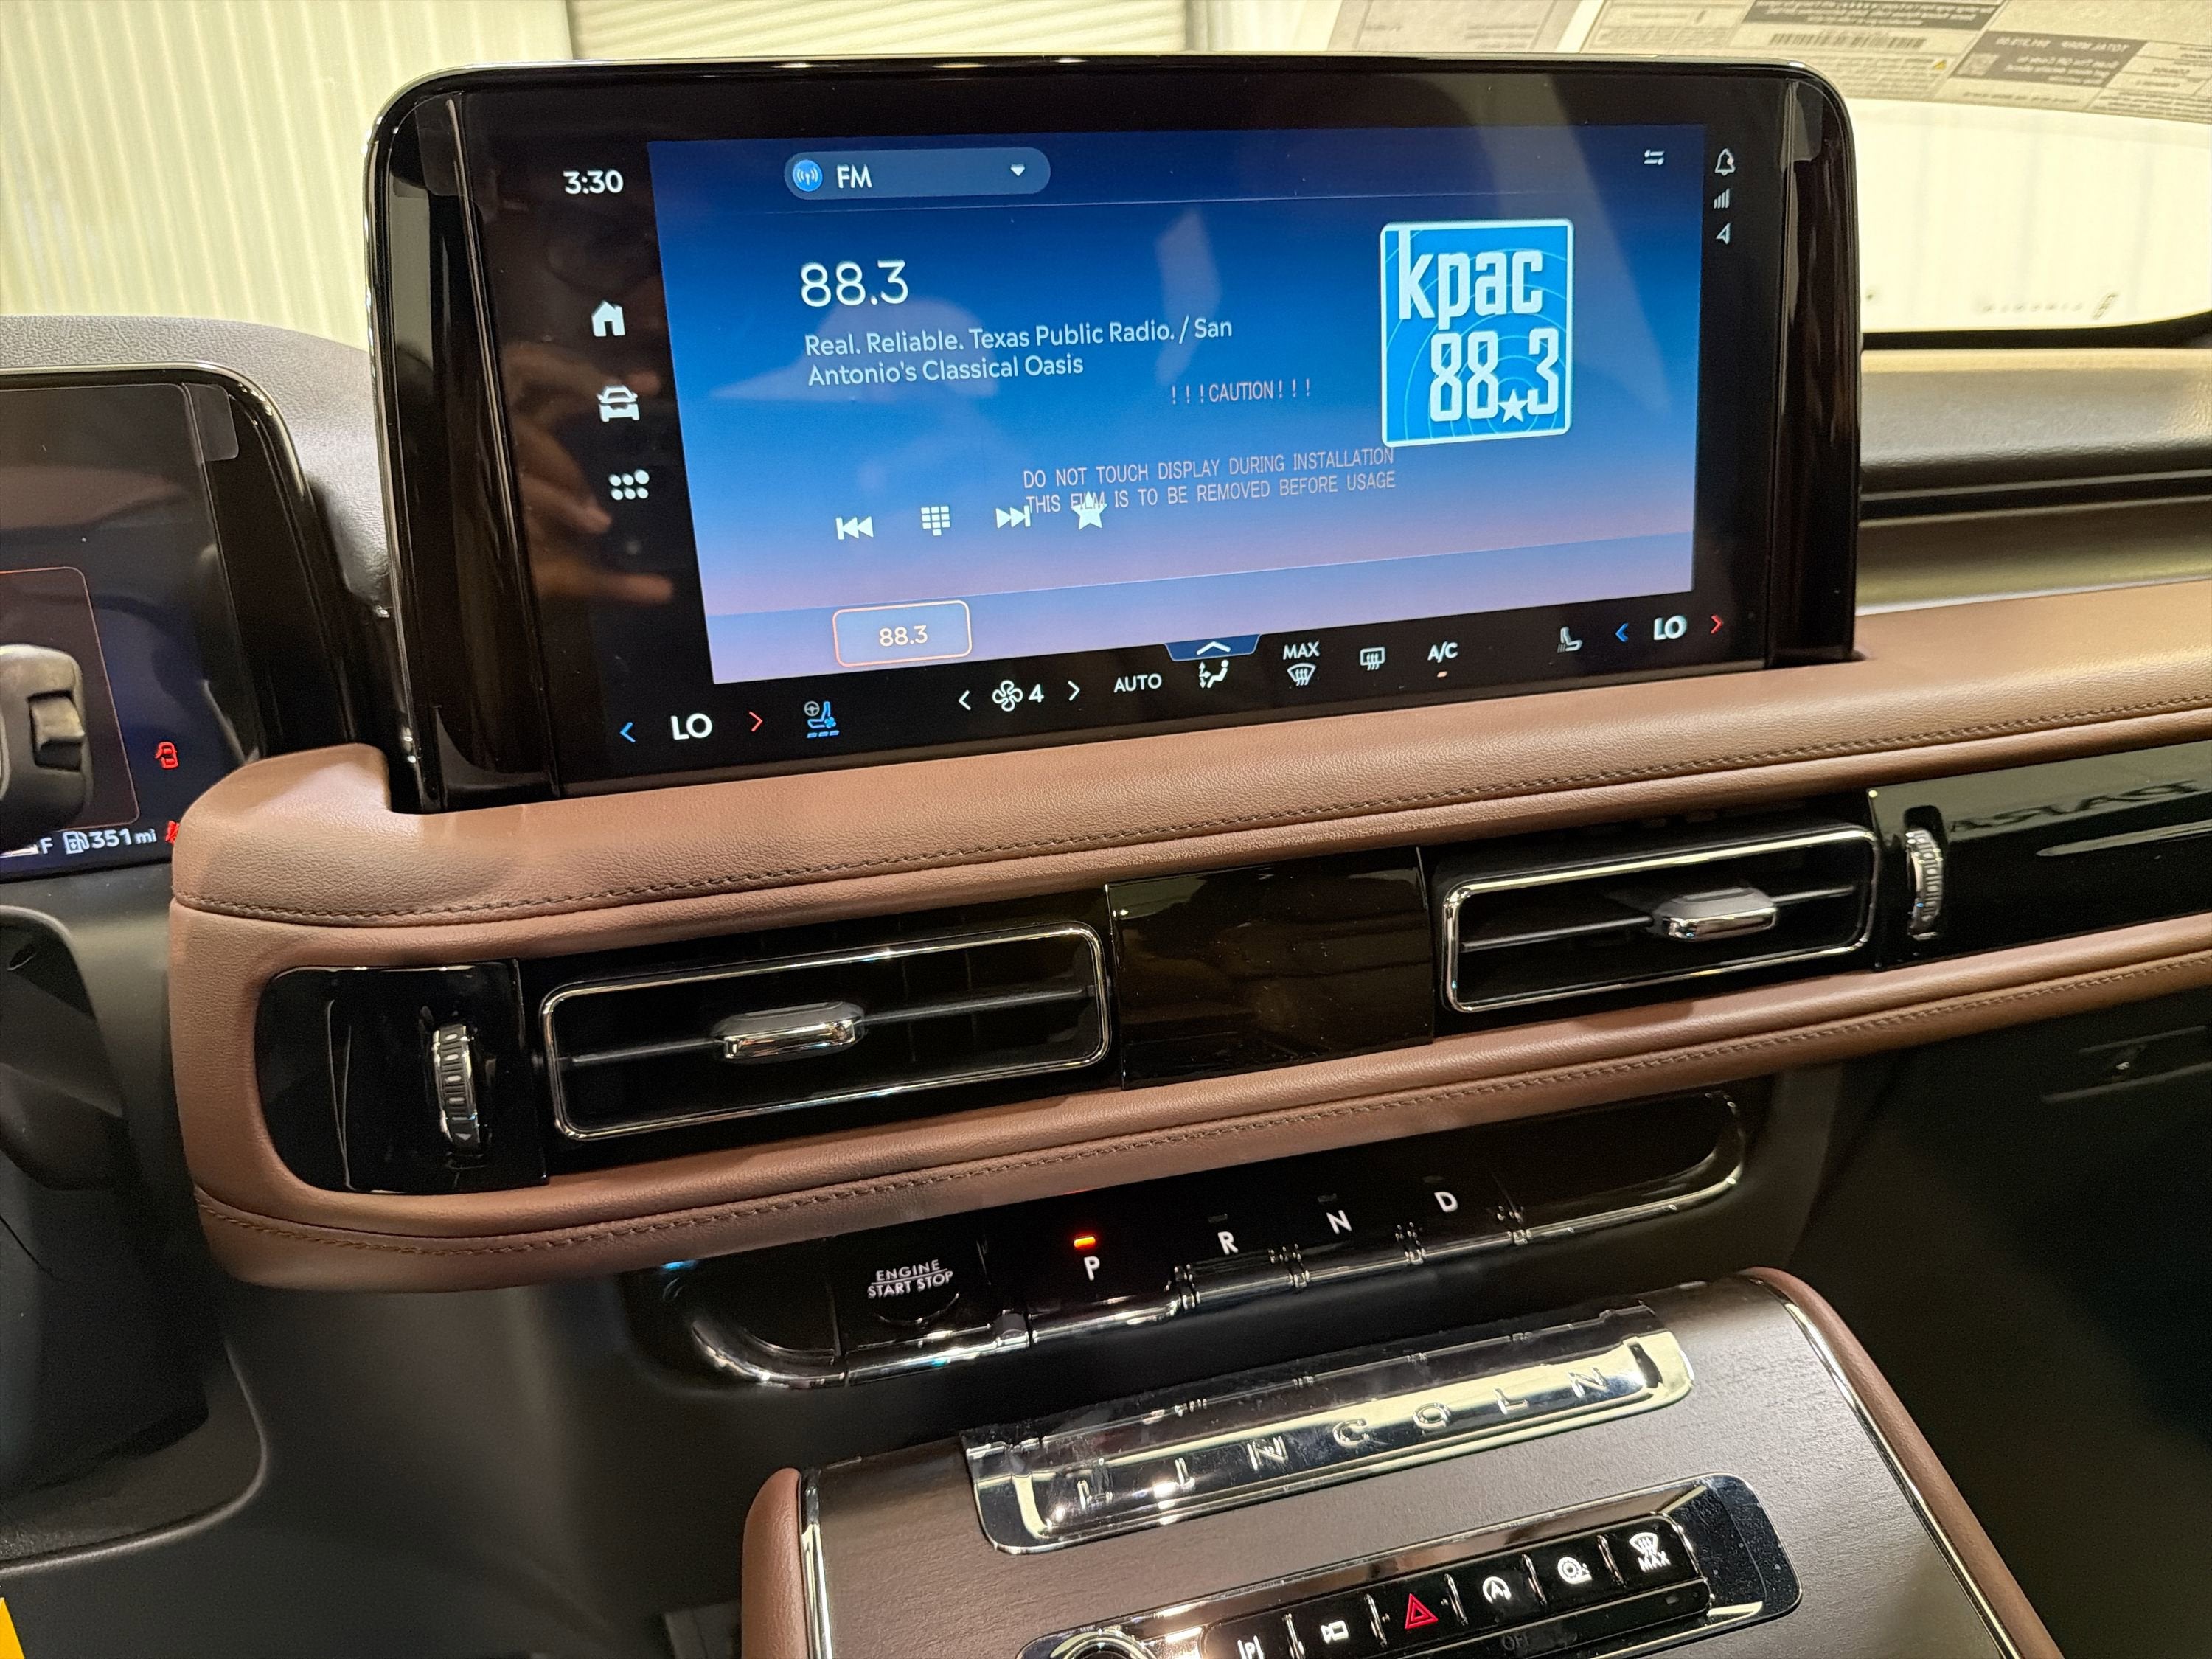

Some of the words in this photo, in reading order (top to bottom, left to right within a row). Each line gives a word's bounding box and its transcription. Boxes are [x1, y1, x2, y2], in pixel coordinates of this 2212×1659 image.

[563, 170, 624, 195] 3:30
[837, 164, 872, 188] FM
[801, 260, 908, 307] 88.3
[1398, 229, 1543, 330] kpac
[805, 334, 861, 356] Real.
[866, 329, 964, 354] Reliable.
[968, 327, 1029, 349] Texas
[1036, 322, 1104, 346] Public
[1109, 319, 1175, 343] Radio.
[1194, 317, 1232, 338] San
[808, 361, 917, 386] Antonio's
[922, 355, 1018, 381] Classical
[1025, 352, 1084, 376] Oasis
[1023, 470, 1046, 488] DO
[1056, 467, 1087, 487] NOT
[1096, 463, 1148, 484] TOUCH
[1158, 459, 1220, 480] DISPLAY
[1229, 454, 1284, 475] DURING
[1294, 448, 1394, 470] INSTALLATION
[1026, 494, 1060, 514] THIS
[1114, 490, 1129, 508] IS
[1138, 487, 1158, 507] TO
[1167, 486, 1188, 504] BE
[1197, 481, 1270, 502] REMOVED
[1279, 475, 1338, 496] BEFORE
[1346, 470, 1396, 492] USAGE
[879, 624, 928, 647] 88.3
[1654, 615, 1688, 641] LO
[1282, 641, 1320, 661] MAX
[1428, 641, 1458, 661] A/C
[1029, 684, 1045, 703] 4
[1114, 674, 1162, 695] AUTO
[671, 713, 713, 741] LO
[40, 837, 53, 854] F
[89, 828, 131, 848] 351
[134, 829, 157, 844] mi
[1434, 1191, 1458, 1212] D
[1326, 1210, 1352, 1234] N
[1217, 1231, 1238, 1254] R
[876, 1259, 940, 1281] ENGINE
[1084, 1256, 1099, 1281] P
[867, 1281, 912, 1298] START
[917, 1270, 953, 1292] STOP
[1638, 1550, 1672, 1573] MAX
